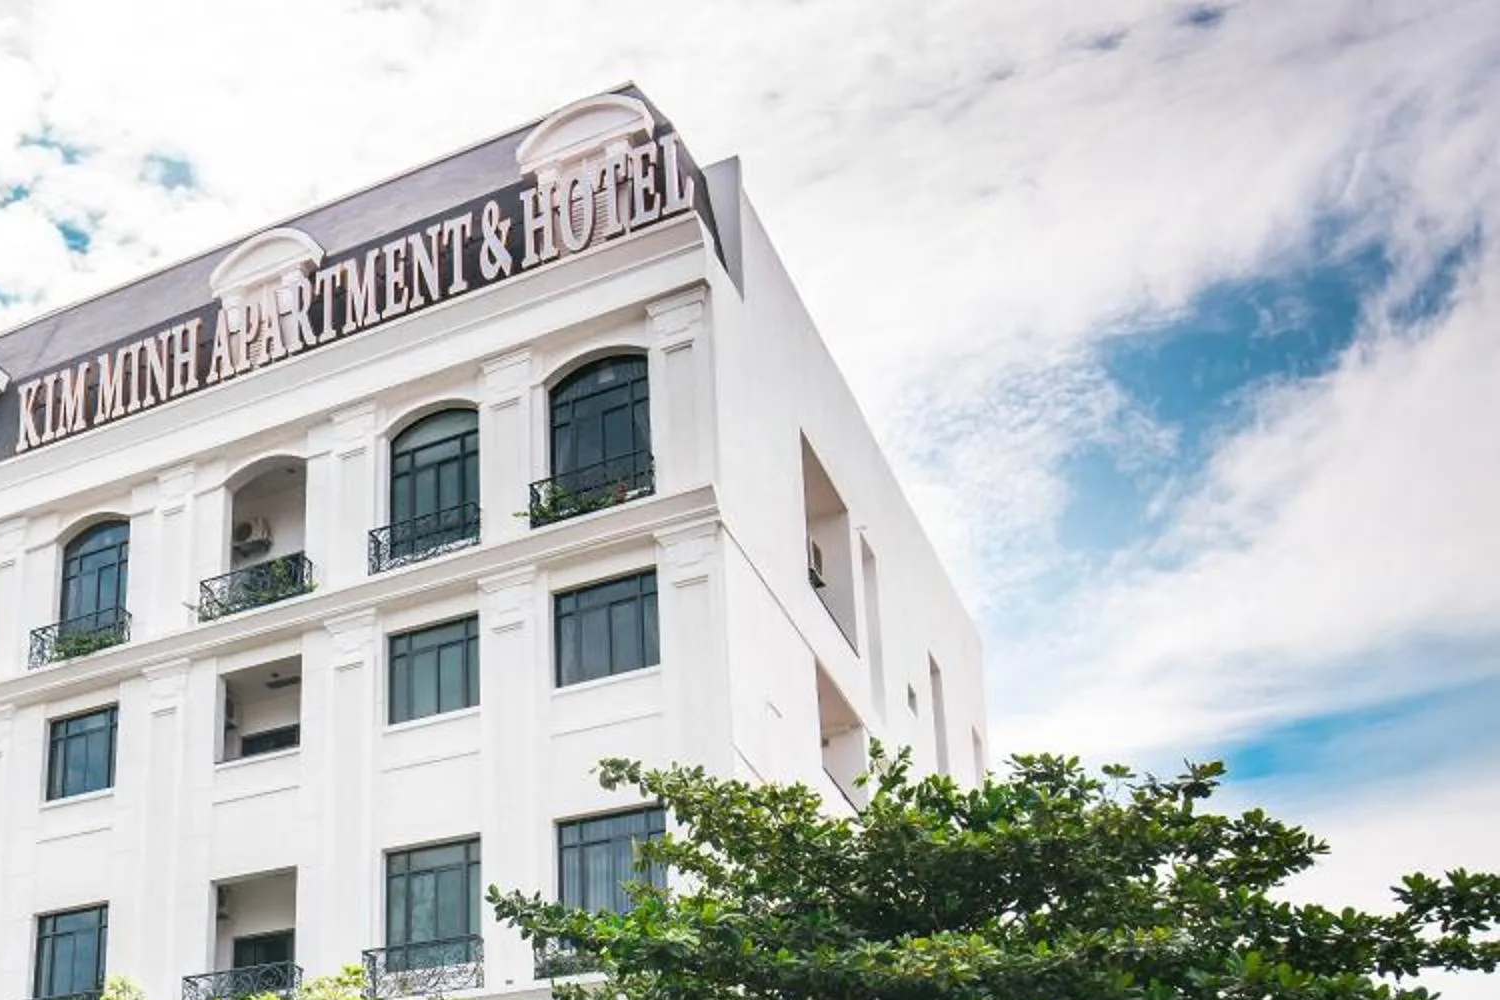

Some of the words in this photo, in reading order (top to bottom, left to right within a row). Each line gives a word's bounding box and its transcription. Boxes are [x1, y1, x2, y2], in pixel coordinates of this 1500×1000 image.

[15, 361, 93, 451] KIM
[94, 316, 202, 425] MINH
[206, 213, 473, 385] APARTMENT
[479, 200, 513, 281] &
[520, 133, 695, 270] HOTEL
